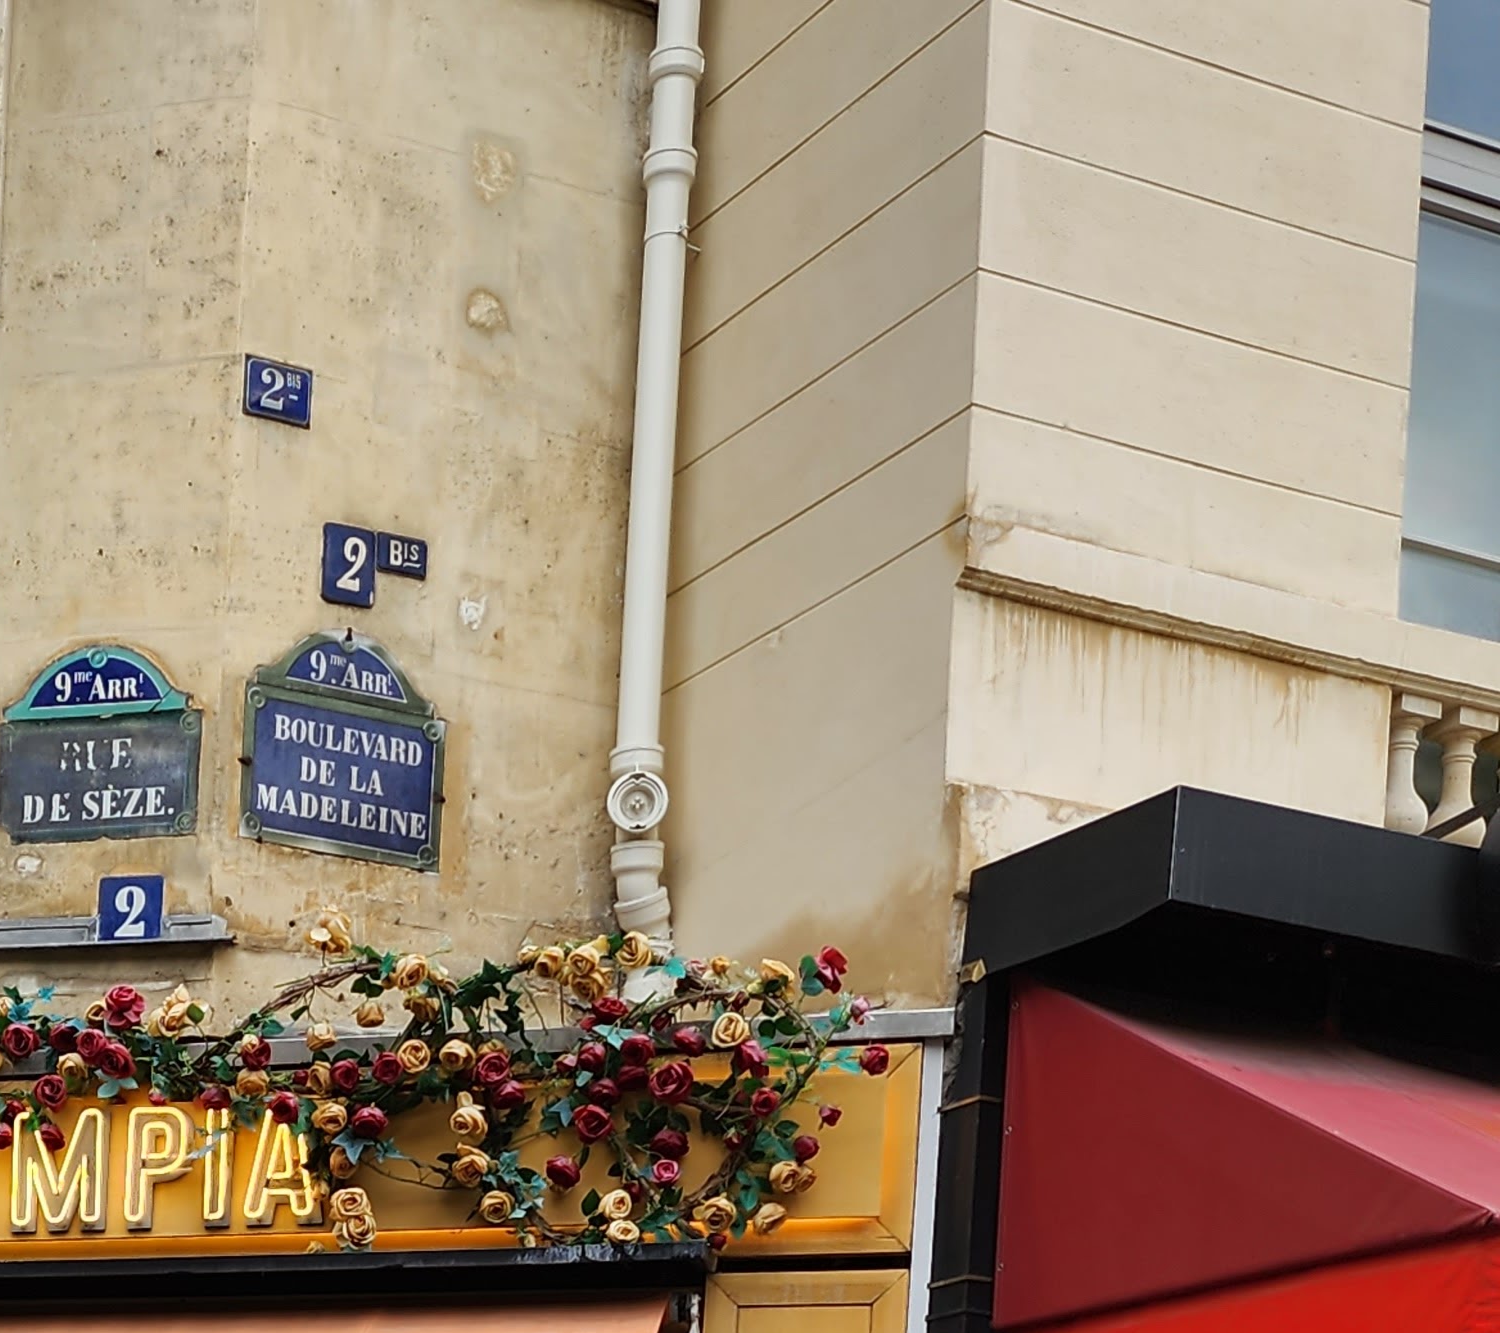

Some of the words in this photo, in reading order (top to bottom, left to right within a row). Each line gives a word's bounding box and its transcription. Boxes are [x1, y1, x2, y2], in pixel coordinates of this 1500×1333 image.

[260, 367, 285, 411] 2
[286, 372, 302, 391] BIS
[336, 536, 367, 592] 2
[389, 539, 422, 568] BIS
[274, 714, 423, 767] BOULEVARD
[300, 756, 336, 787] DE
[349, 766, 384, 796] LA
[22, 793, 71, 824] DE
[256, 783, 428, 840] MADELEINE
[113, 886, 146, 938] 2
